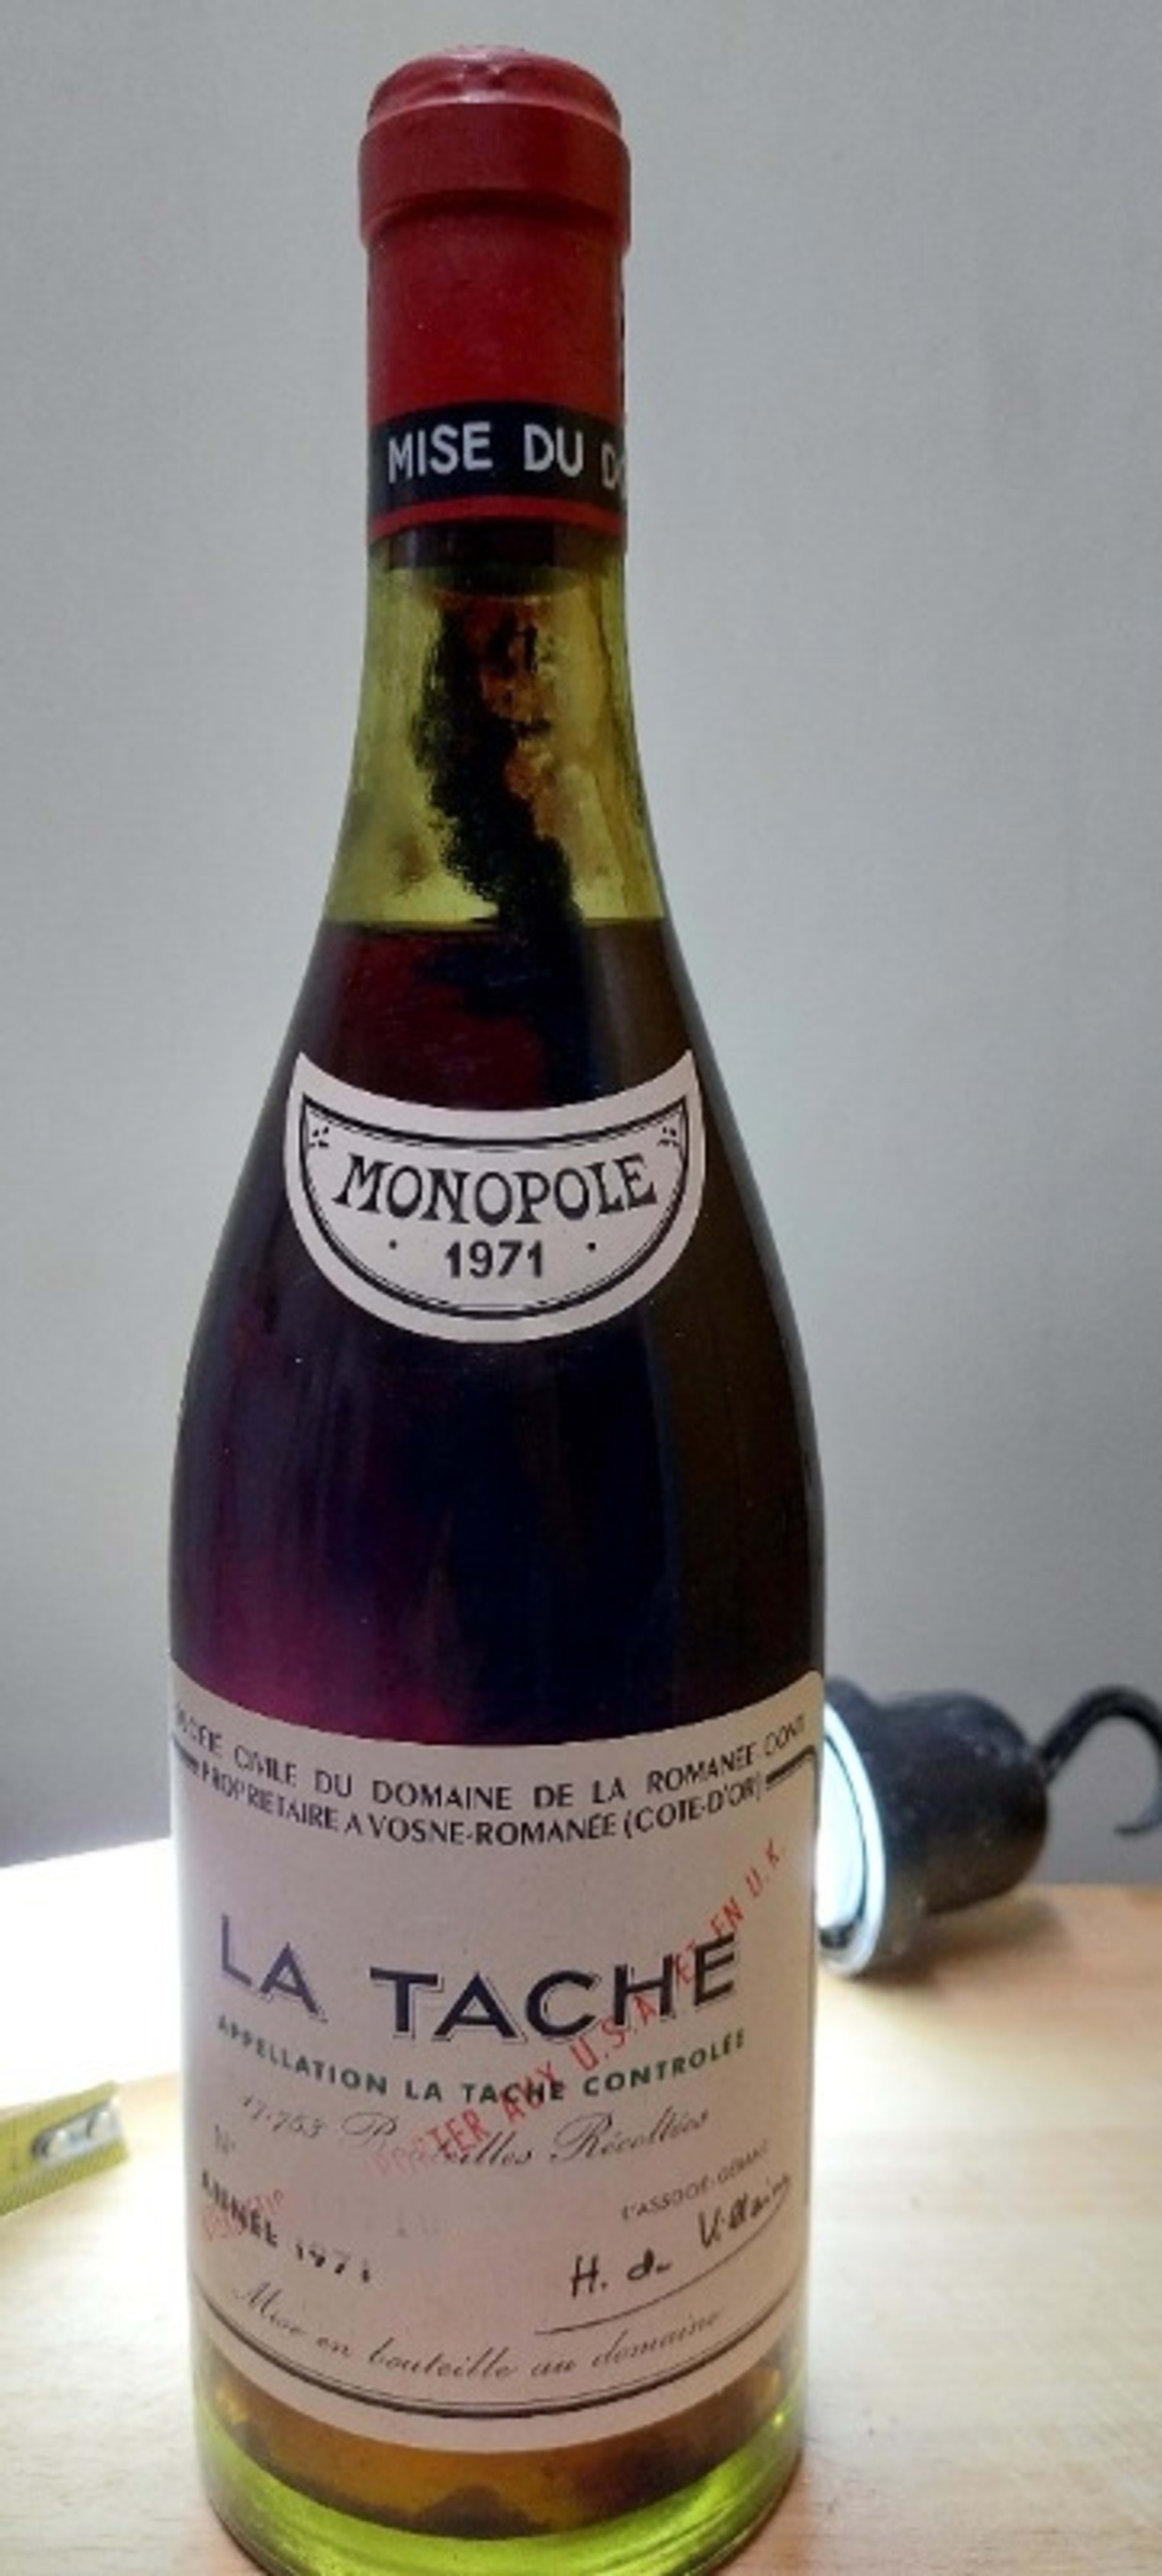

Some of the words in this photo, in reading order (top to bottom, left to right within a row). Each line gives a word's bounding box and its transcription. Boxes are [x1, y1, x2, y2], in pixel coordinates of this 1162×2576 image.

[388, 421, 493, 484] MISE
[523, 423, 584, 477] DU
[332, 1153, 657, 1226] MONOPOLE
[444, 1240, 543, 1279] 1971
[314, 1770, 353, 1798] DU
[372, 1779, 512, 1811] DOMAINE
[533, 1782, 573, 1809] DE
[592, 1776, 626, 1805] LA
[344, 1812, 365, 1836] A
[221, 1913, 329, 2024] LA
[369, 1931, 739, 2044] TACHE
[217, 2015, 388, 2096] APPELLATION
[405, 2079, 443, 2102] LA
[461, 2074, 566, 2106] TACHE
[570, 2253, 609, 2299] H.
[315, 2336, 350, 2358] en
[369, 2336, 518, 2379] bouteille
[530, 2359, 576, 2377] au
[591, 2311, 722, 2368] domaine
